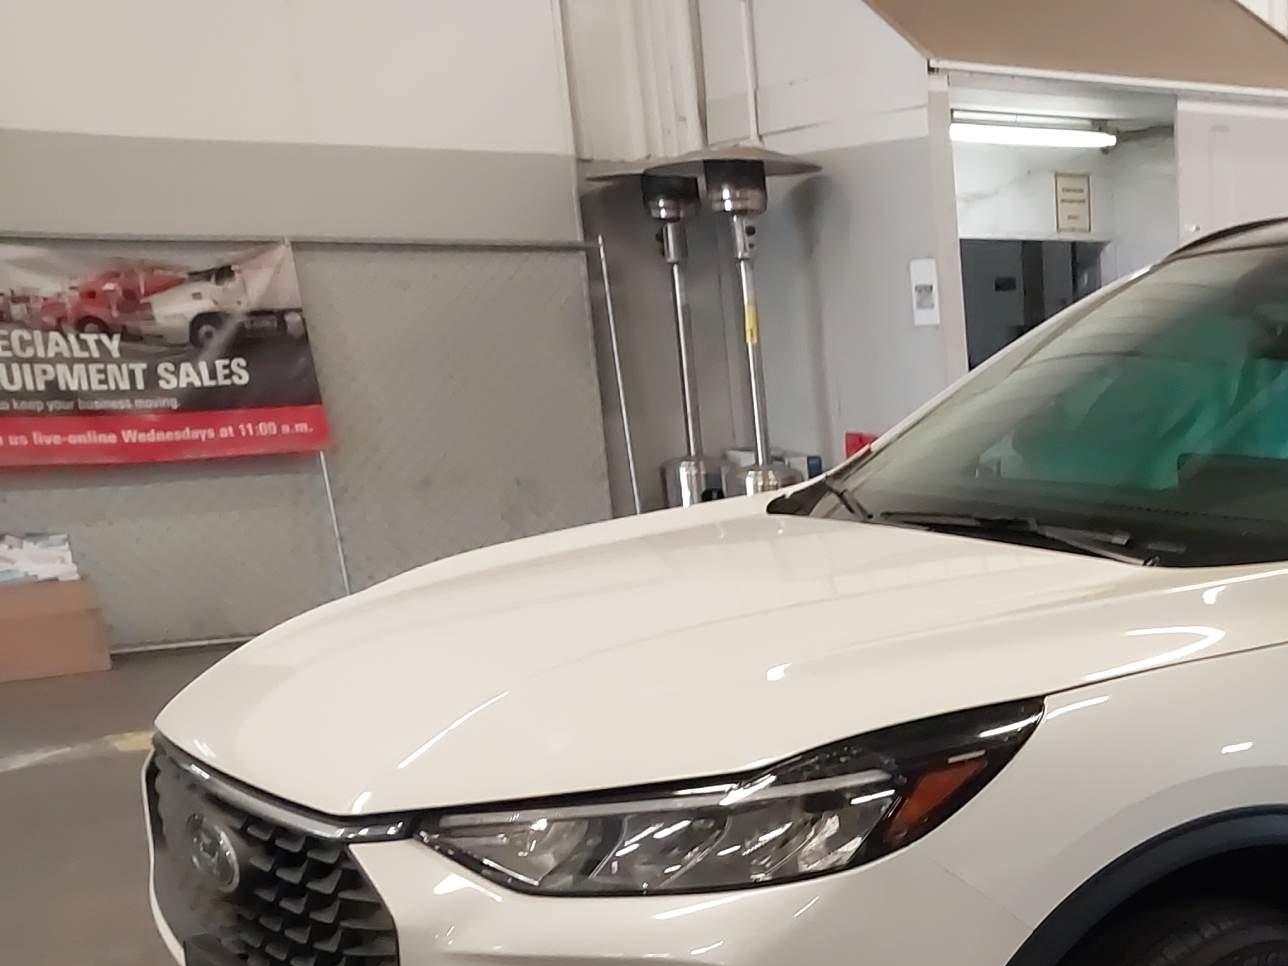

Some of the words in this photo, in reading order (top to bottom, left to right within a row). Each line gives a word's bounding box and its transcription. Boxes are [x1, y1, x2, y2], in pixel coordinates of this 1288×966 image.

[157, 357, 250, 390] SALES
[8, 435, 29, 446] us
[32, 430, 118, 446] live-online
[121, 427, 215, 443] Wednesdays
[219, 426, 235, 438] at
[239, 422, 278, 436] 11:00
